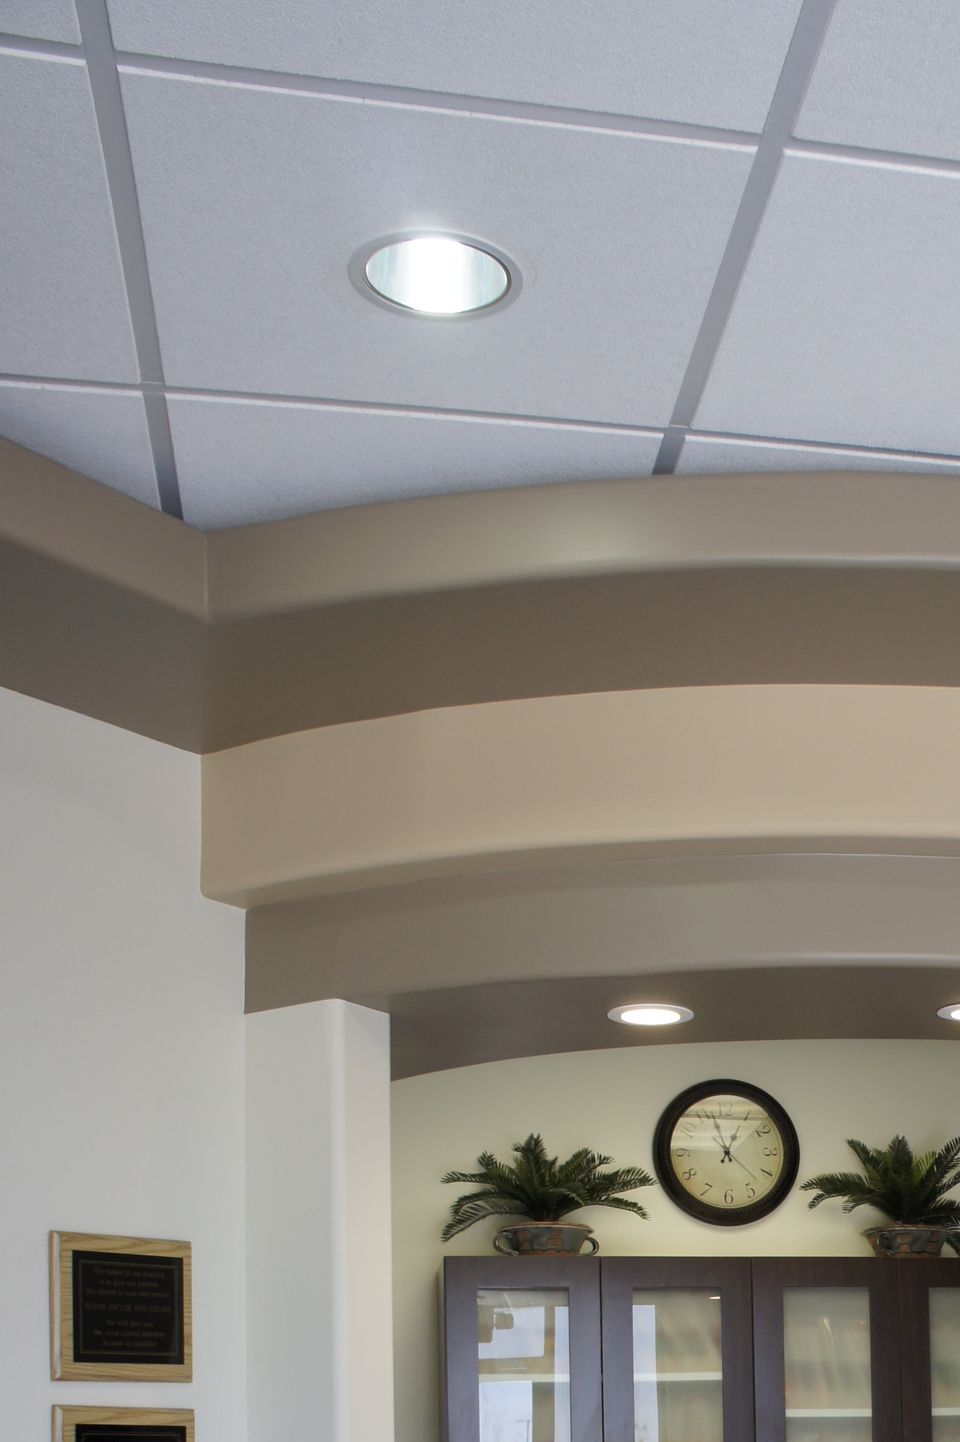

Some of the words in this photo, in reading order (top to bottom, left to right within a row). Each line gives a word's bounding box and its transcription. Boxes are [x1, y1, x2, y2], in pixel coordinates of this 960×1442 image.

[718, 1102, 733, 1117] 12
[755, 1125, 771, 1138] 2
[675, 1147, 690, 1158] 9
[763, 1146, 777, 1157] 3
[683, 1167, 697, 1181] 8
[700, 1182, 713, 1197] 7
[724, 1188, 734, 1204] 6
[745, 1182, 756, 1199] 5
